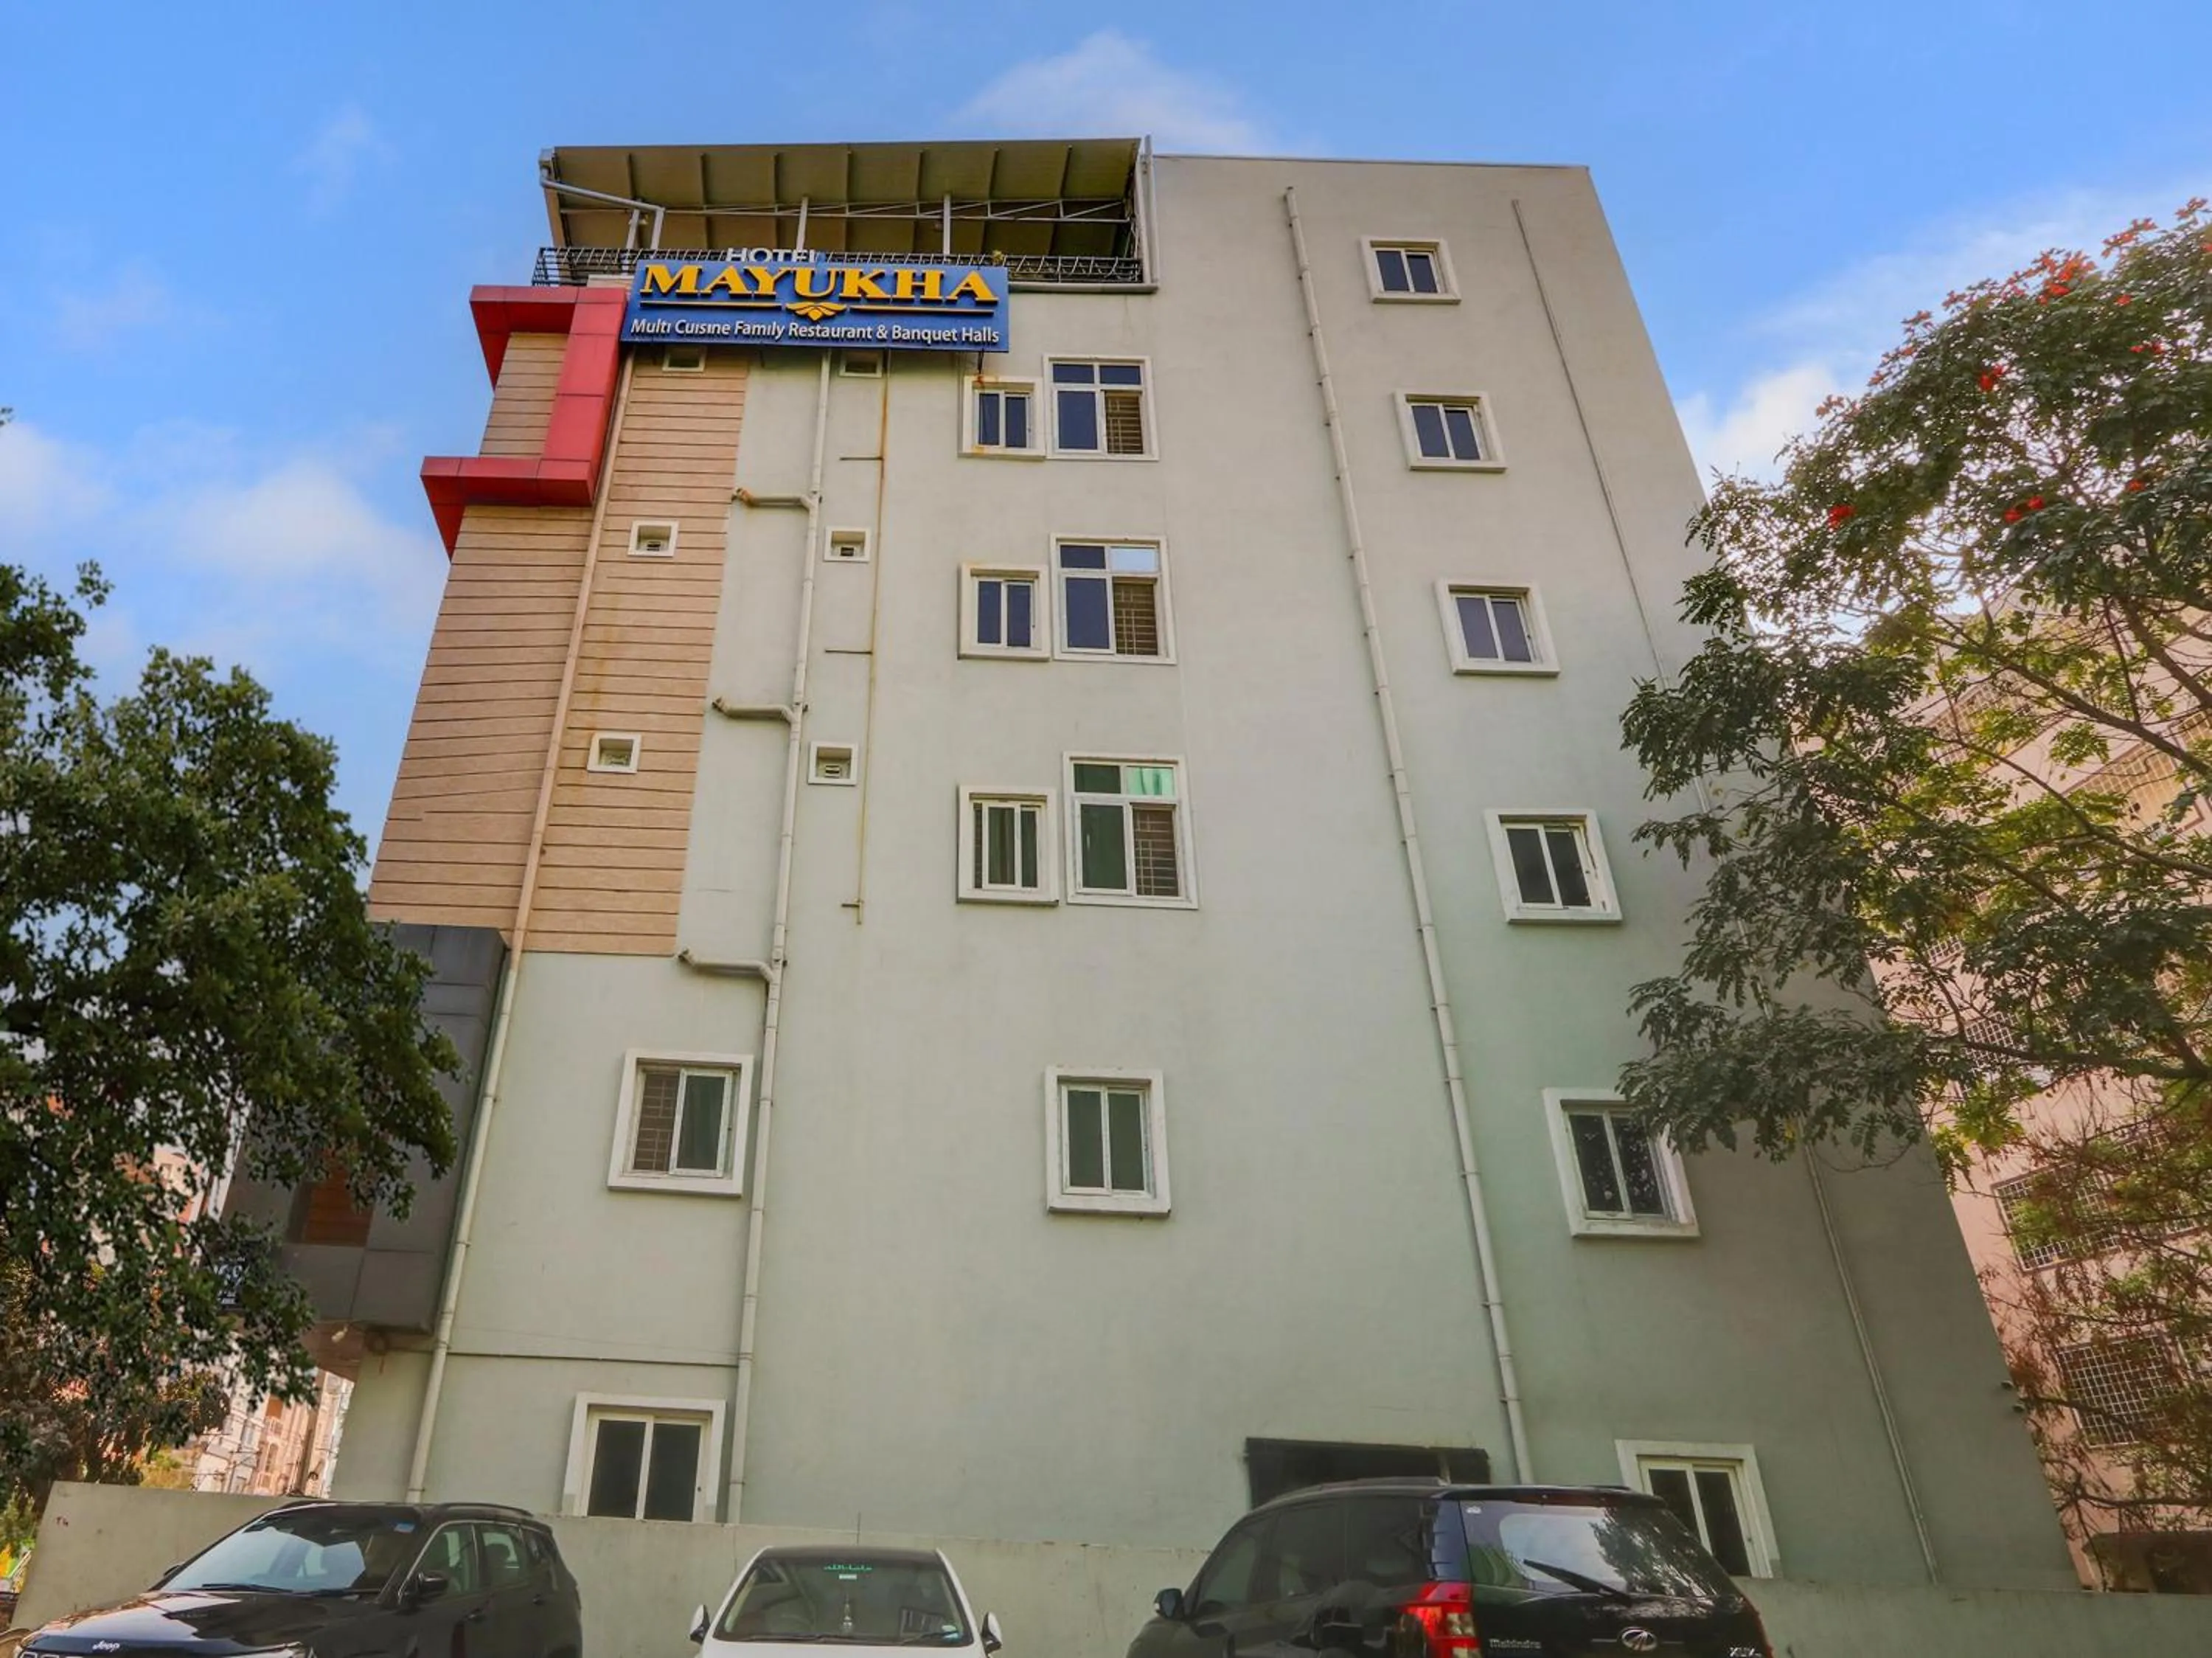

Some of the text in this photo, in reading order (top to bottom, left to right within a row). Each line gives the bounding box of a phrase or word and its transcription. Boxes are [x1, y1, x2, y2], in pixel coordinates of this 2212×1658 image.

[640, 264, 999, 302] MAYUKHA
[631, 318, 1000, 344] Multi Cuisine Family Restaurant & Banquet Halls
